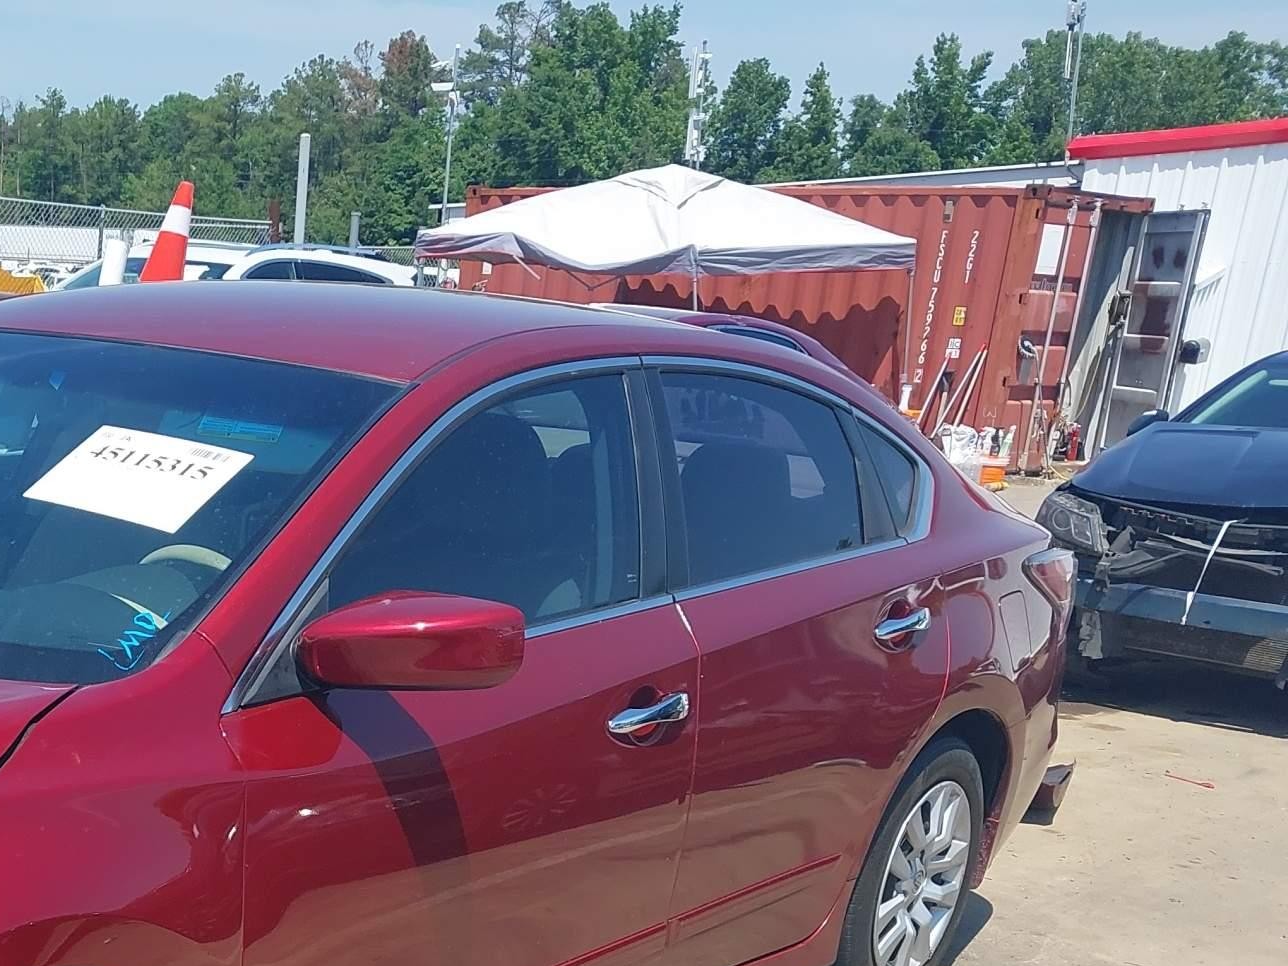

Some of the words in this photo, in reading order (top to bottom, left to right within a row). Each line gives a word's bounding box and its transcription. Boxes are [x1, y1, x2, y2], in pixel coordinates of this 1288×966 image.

[933, 230, 949, 283] FSCU
[964, 230, 980, 284] 22G1
[90, 446, 215, 479] 45115315
